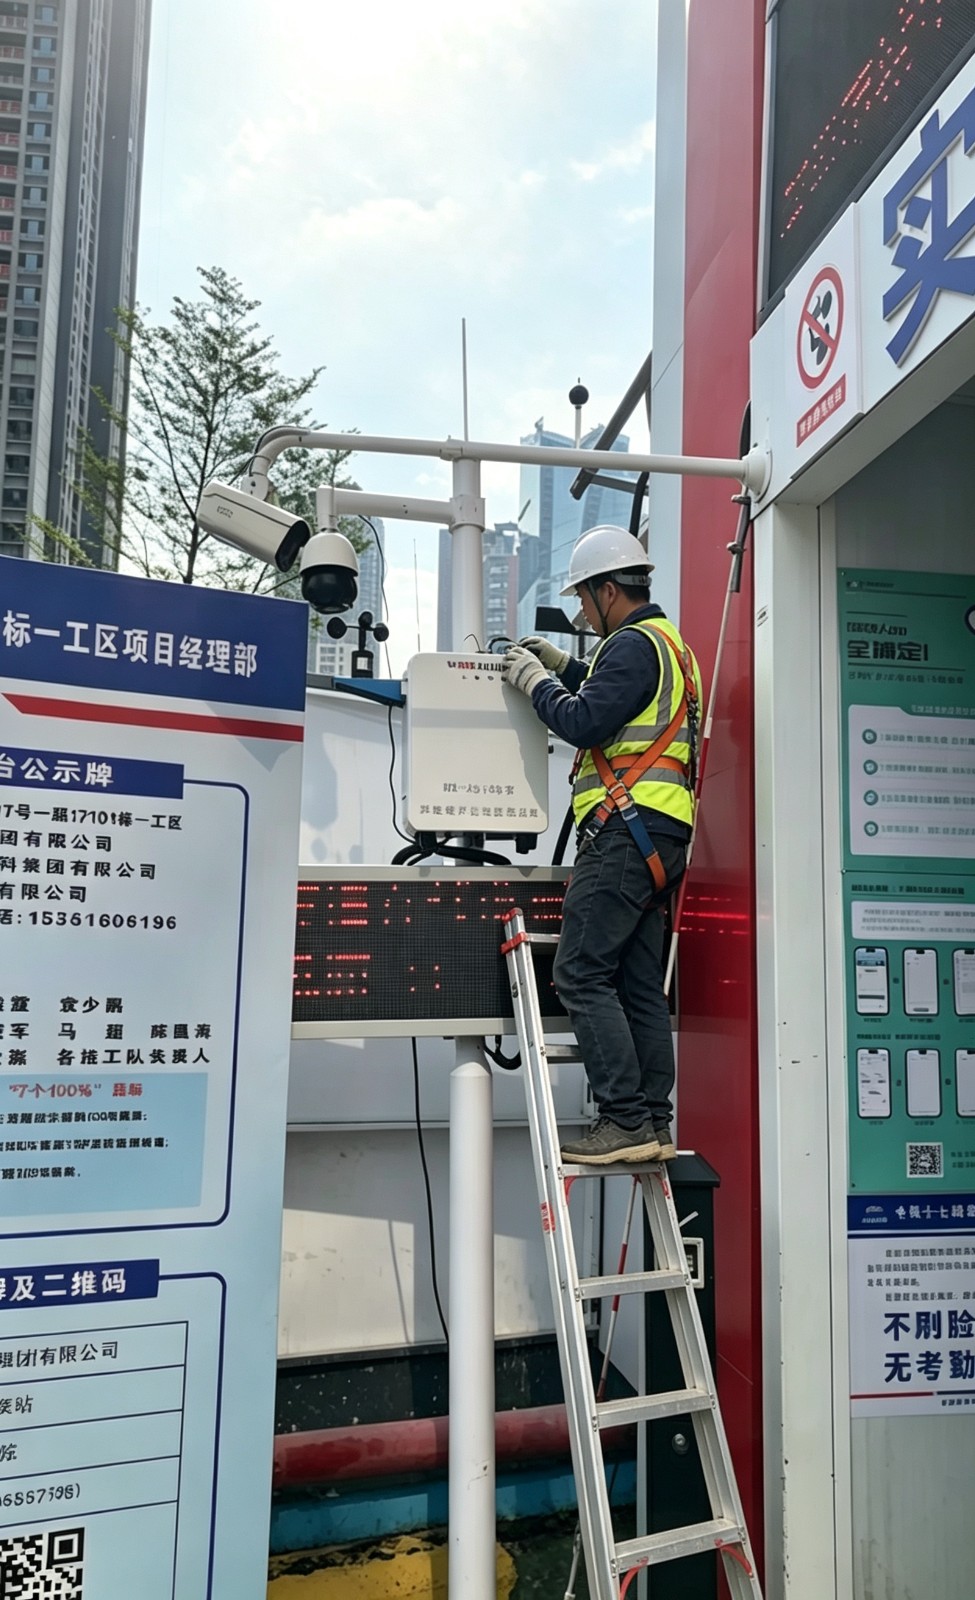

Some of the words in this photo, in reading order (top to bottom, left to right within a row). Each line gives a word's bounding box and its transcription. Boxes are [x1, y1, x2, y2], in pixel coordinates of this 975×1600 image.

[2, 609, 258, 678] 标一工区项目经理部
